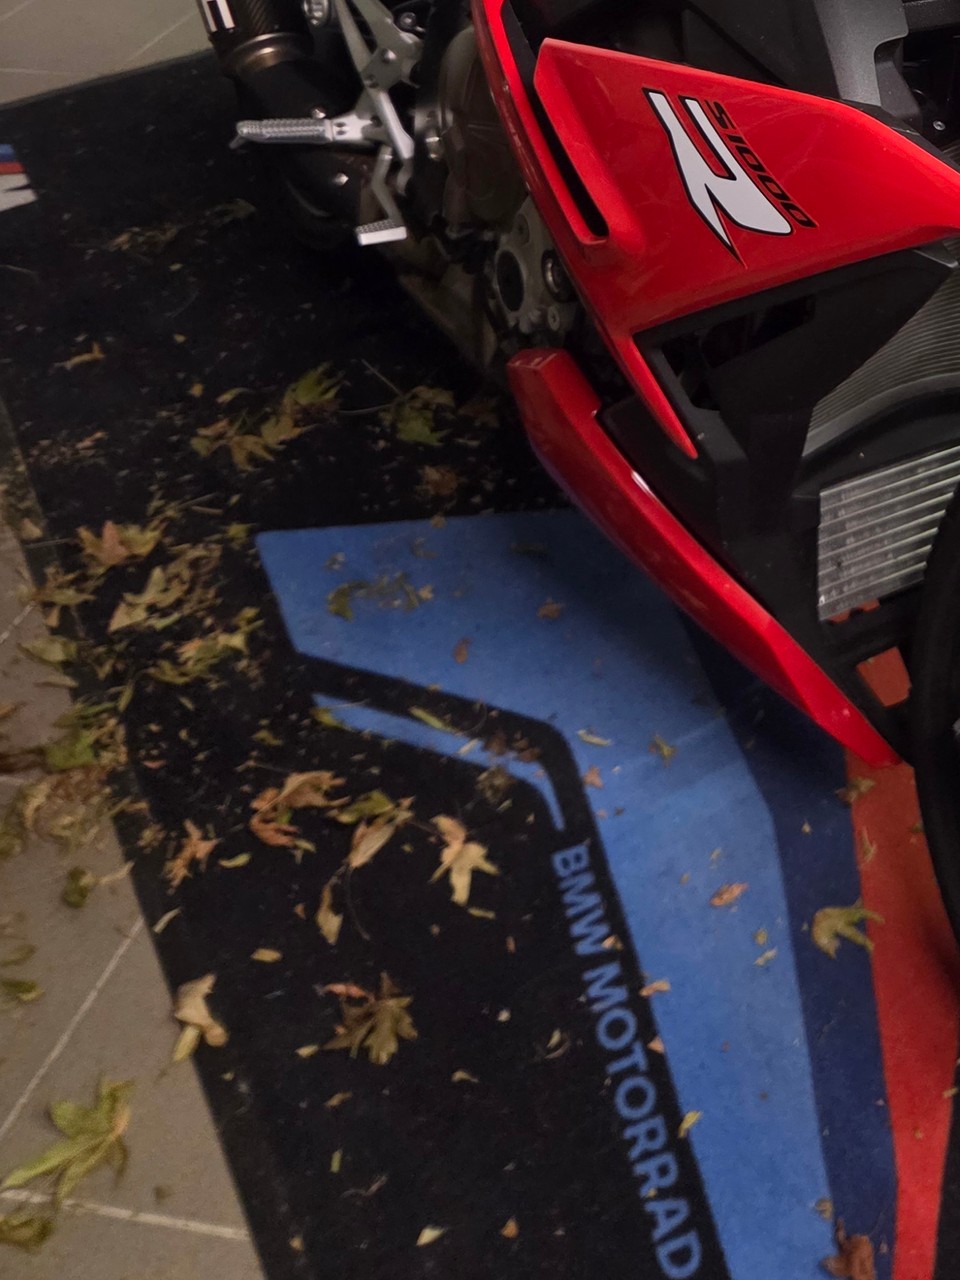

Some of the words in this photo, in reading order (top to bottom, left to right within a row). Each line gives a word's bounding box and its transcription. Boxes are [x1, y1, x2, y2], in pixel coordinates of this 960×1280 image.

[704, 99, 819, 229] S1000
[553, 843, 611, 956] BMW
[582, 961, 702, 1280] MOTORRAD
